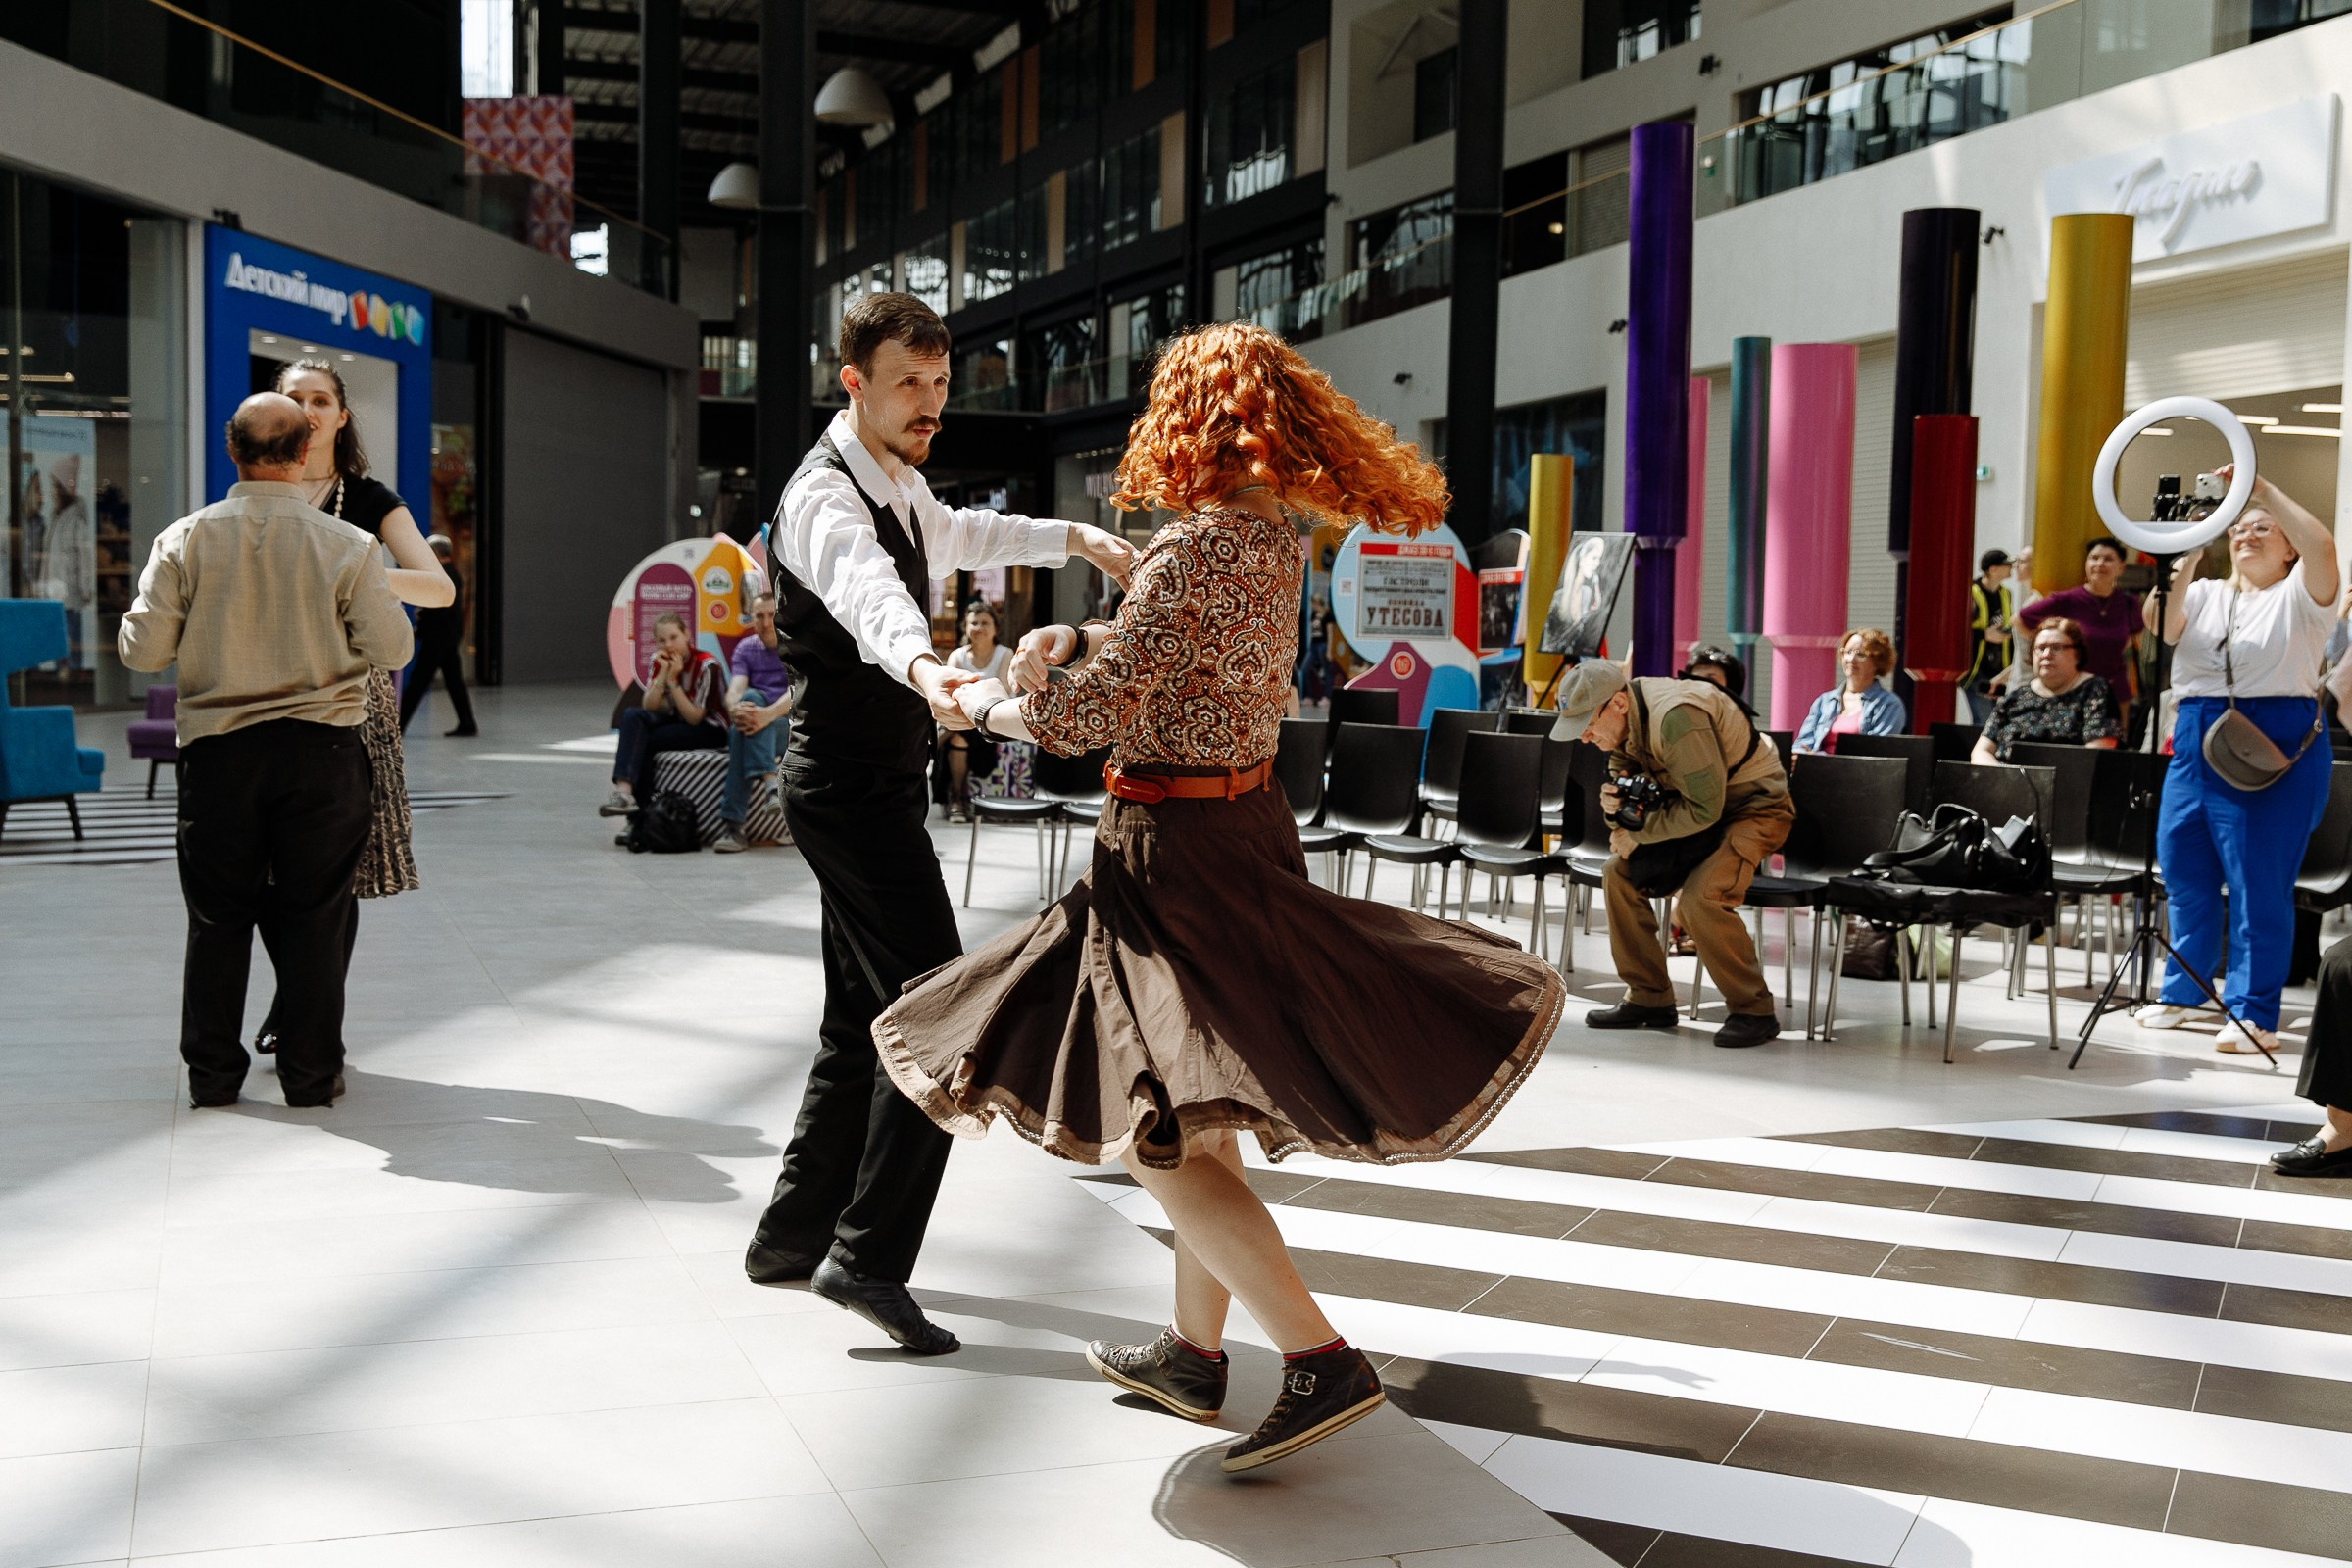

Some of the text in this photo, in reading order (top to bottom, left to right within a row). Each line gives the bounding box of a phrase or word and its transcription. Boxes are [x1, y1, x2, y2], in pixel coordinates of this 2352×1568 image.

[224, 252, 348, 326] Детский мир
[1367, 606, 1444, 627] УТЕСОВА
